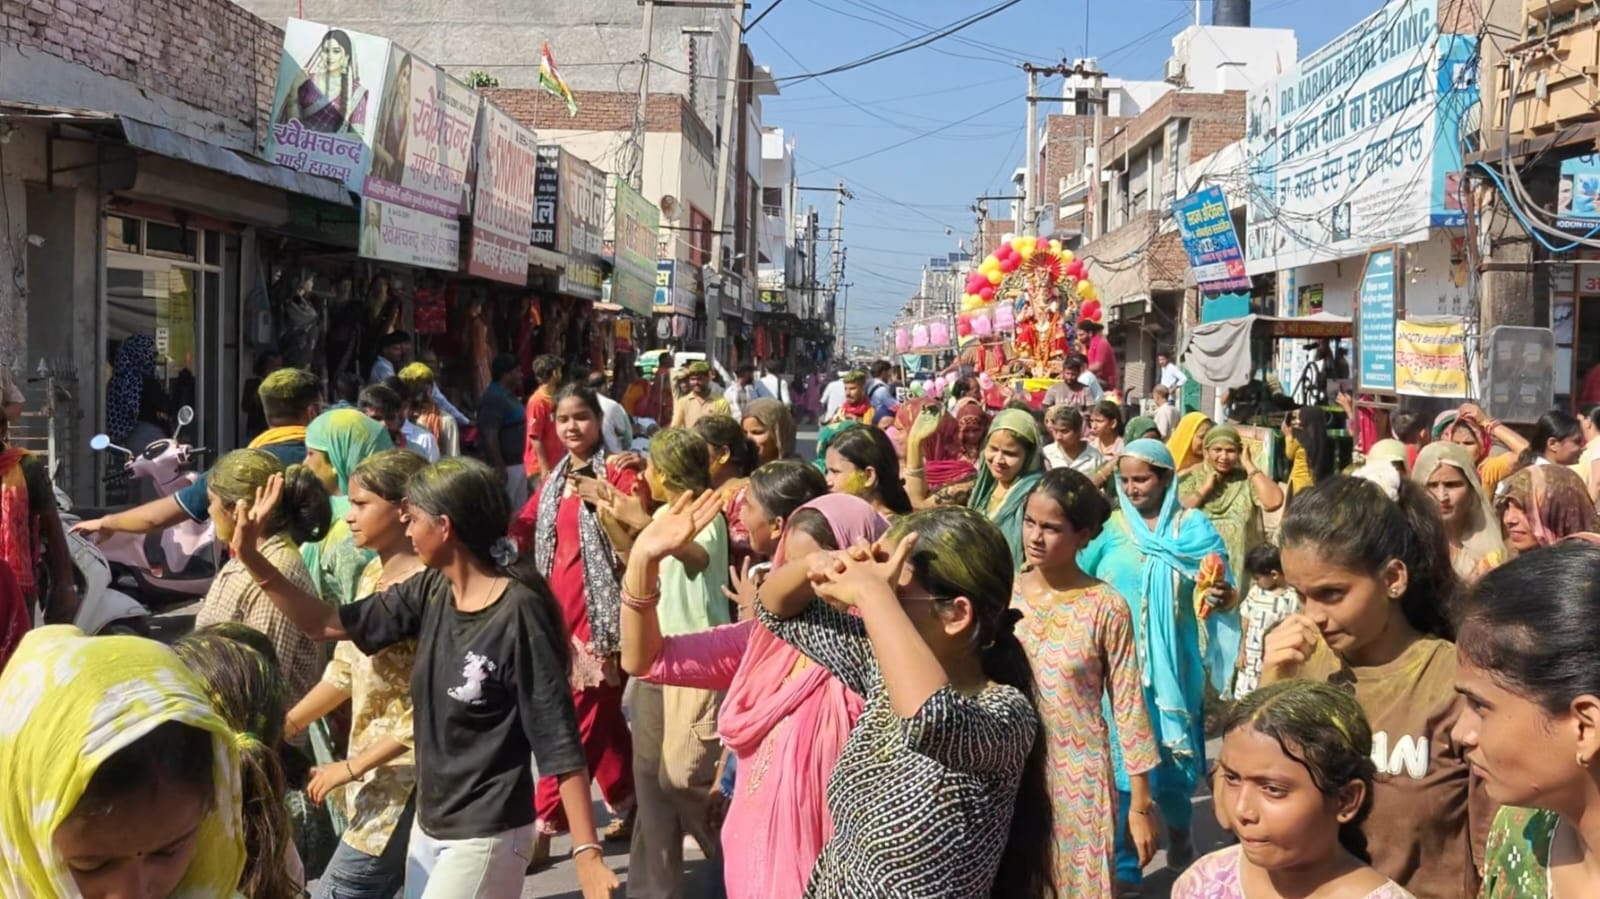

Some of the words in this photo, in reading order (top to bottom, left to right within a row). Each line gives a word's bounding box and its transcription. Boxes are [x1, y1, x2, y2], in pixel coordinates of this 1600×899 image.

[1281, 86, 1296, 116] DR.
[1380, 7, 1431, 62] CLINIC
[1349, 93, 1367, 131] का
